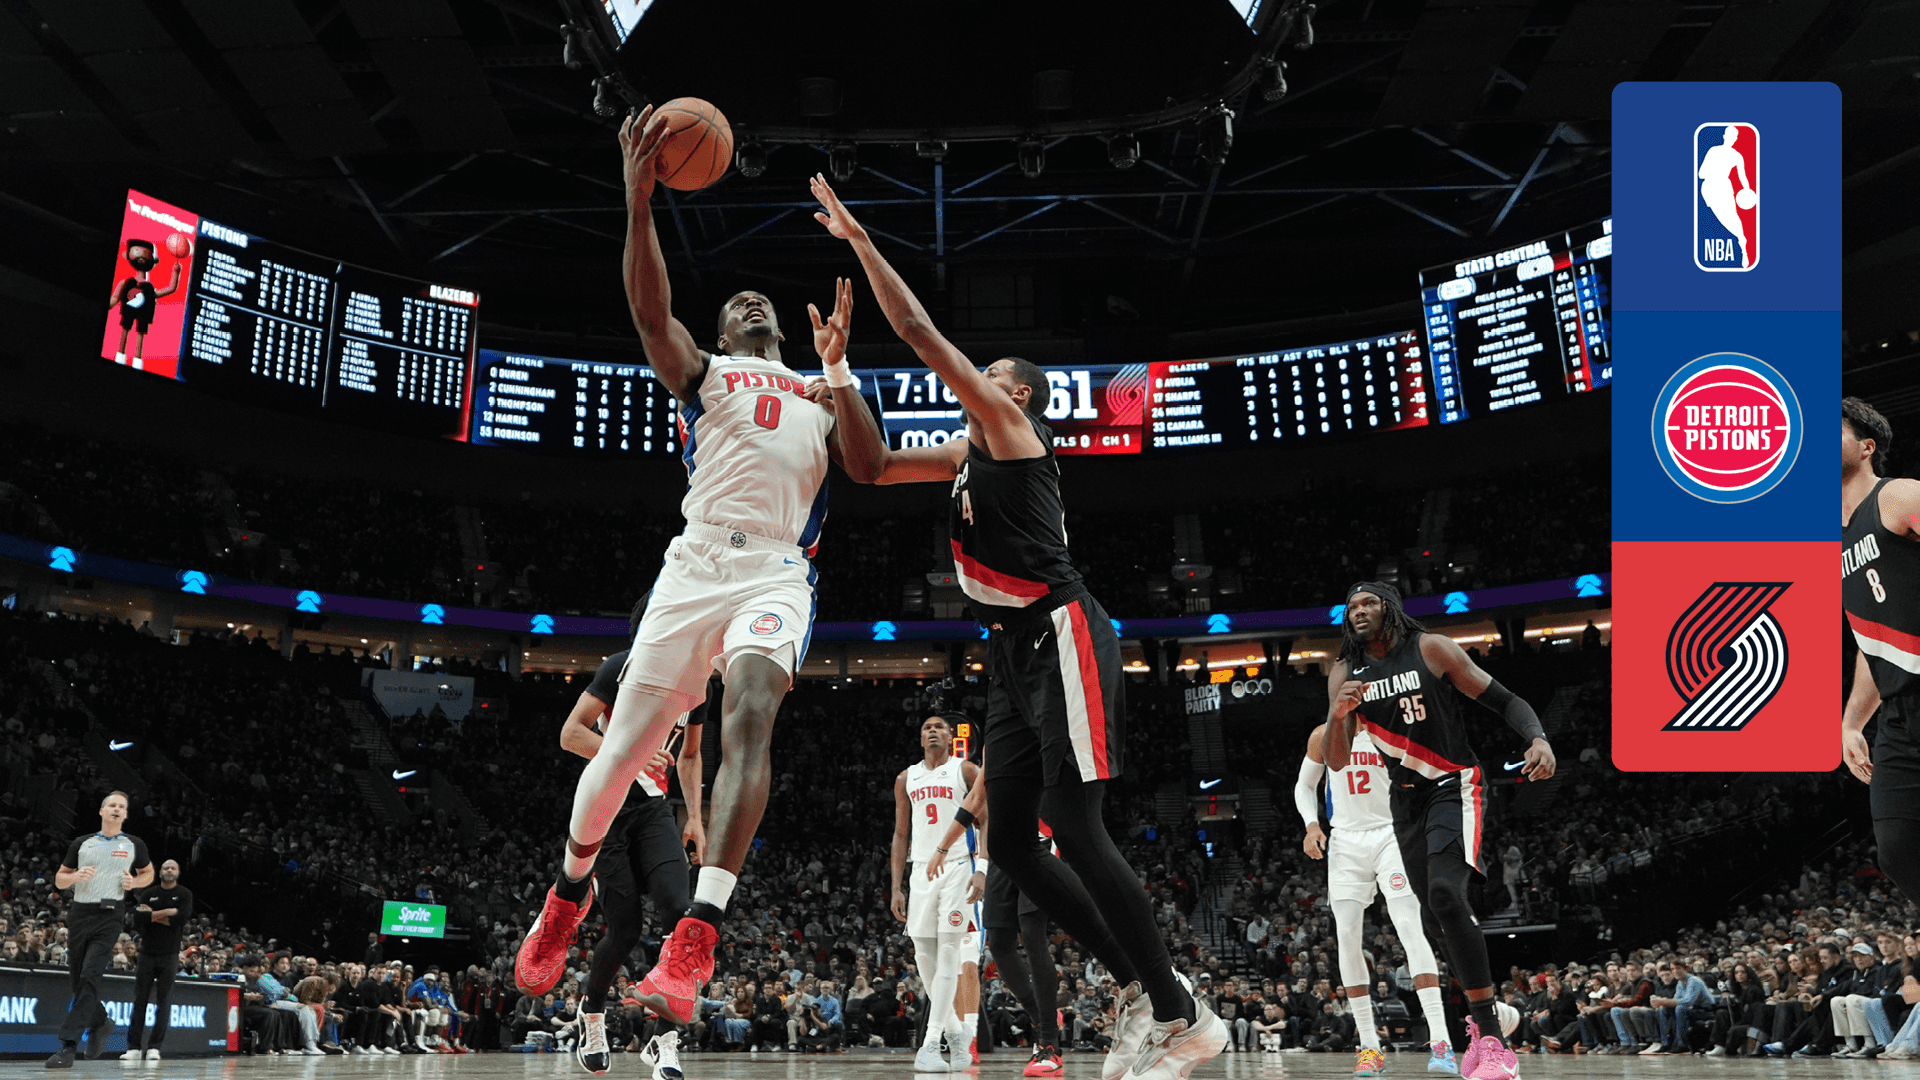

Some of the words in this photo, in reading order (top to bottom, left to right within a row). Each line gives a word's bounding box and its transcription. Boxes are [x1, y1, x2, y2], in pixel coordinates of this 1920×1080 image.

[201, 220, 249, 249] PISTONS
[1455, 256, 1494, 278] STATS
[1495, 240, 1550, 267] CENTRAL
[429, 284, 475, 304] BLAZERS
[506, 356, 543, 368] PISTONS
[571, 363, 589, 373] PTS
[593, 365, 613, 375] REB
[616, 367, 635, 376] AST
[639, 368, 656, 378] STL
[1168, 362, 1210, 374] BLAZERS
[1236, 356, 1255, 367] PTS
[1258, 354, 1279, 364] REB
[1282, 351, 1302, 362] AST
[1306, 349, 1325, 359] STL
[1329, 344, 1350, 356] BLK
[1355, 341, 1370, 351] TO
[1377, 336, 1397, 348] FLS
[1243, 370, 1254, 382] 11
[1314, 362, 1323, 373] 0
[1338, 358, 1347, 370] 0
[1362, 354, 1370, 366] 2
[1386, 351, 1395, 362] 0
[490, 366, 498, 378] 0
[498, 368, 529, 381] DUREN
[576, 377, 588, 388] 12
[601, 379, 609, 390] 2
[623, 381, 631, 392] 2
[647, 382, 653, 393] 1
[722, 371, 808, 400] PISTON
[1152, 392, 1164, 404] 17
[1164, 390, 1201, 403] SHARPE
[1242, 385, 1257, 397] 20
[1269, 383, 1277, 394] 2
[1292, 380, 1300, 391] 2
[1340, 373, 1348, 385] 0
[1388, 366, 1395, 377] 1
[488, 381, 497, 393] 2
[497, 383, 556, 398] CUNNINGHAM
[645, 396, 653, 408] 2
[668, 398, 676, 409] 0
[1043, 370, 1099, 420] 61
[1166, 405, 1202, 417] MURRAY
[1246, 400, 1255, 411] 3
[1271, 397, 1278, 408] 1
[1294, 394, 1302, 406] 0
[1318, 391, 1326, 403] 0
[1341, 388, 1350, 400] 0
[1366, 384, 1374, 396] 0
[1390, 380, 1398, 392] 0
[488, 396, 495, 406] 9
[496, 397, 545, 412] THOMPSON
[574, 405, 586, 417] 10
[597, 408, 609, 419] 10
[622, 410, 630, 421] 3
[646, 411, 652, 422] 1
[668, 412, 676, 423] 0
[753, 394, 782, 430] 0
[1152, 421, 1166, 432] 33
[1166, 420, 1204, 431] CAMARA
[1248, 414, 1256, 426] 3
[1272, 412, 1279, 423] 1
[1296, 409, 1304, 421] 0
[1319, 406, 1328, 418] 0
[1343, 403, 1352, 414] 0
[1367, 400, 1376, 411] 2
[1391, 396, 1400, 406] 3
[482, 410, 494, 423] 12
[494, 412, 528, 426] HARRIS
[576, 420, 584, 432] 8
[598, 422, 606, 434] 2
[621, 424, 629, 435] 3
[644, 426, 652, 437] 0
[668, 427, 674, 438] 1
[1153, 436, 1166, 447] 35
[1167, 433, 1210, 446] WILLIAMS
[1297, 424, 1306, 436] 0
[1321, 421, 1330, 432] 0
[1345, 418, 1352, 429] 1
[1369, 414, 1378, 426] 0
[1394, 410, 1401, 422] 1
[479, 425, 493, 437] 55
[494, 427, 540, 442] ROBINSON
[573, 435, 584, 447] 12
[598, 437, 604, 448] 1
[620, 439, 628, 450] 4
[643, 440, 651, 451] 0
[666, 441, 674, 452] 0
[1053, 436, 1077, 448] FLS
[1080, 434, 1091, 449] 0
[1102, 435, 1120, 447] CH
[1122, 433, 1131, 447] 1
[1865, 567, 1887, 604] 8
[1184, 683, 1221, 702] BLOCK
[1186, 696, 1221, 715] PARTY
[1399, 693, 1427, 725] 35
[1350, 751, 1386, 769] TONS
[910, 785, 953, 805] PISTONS
[1346, 769, 1372, 795] 12
[925, 802, 938, 825] 9
[398, 905, 431, 923] Sprite
[169, 1004, 207, 1029] BANK
